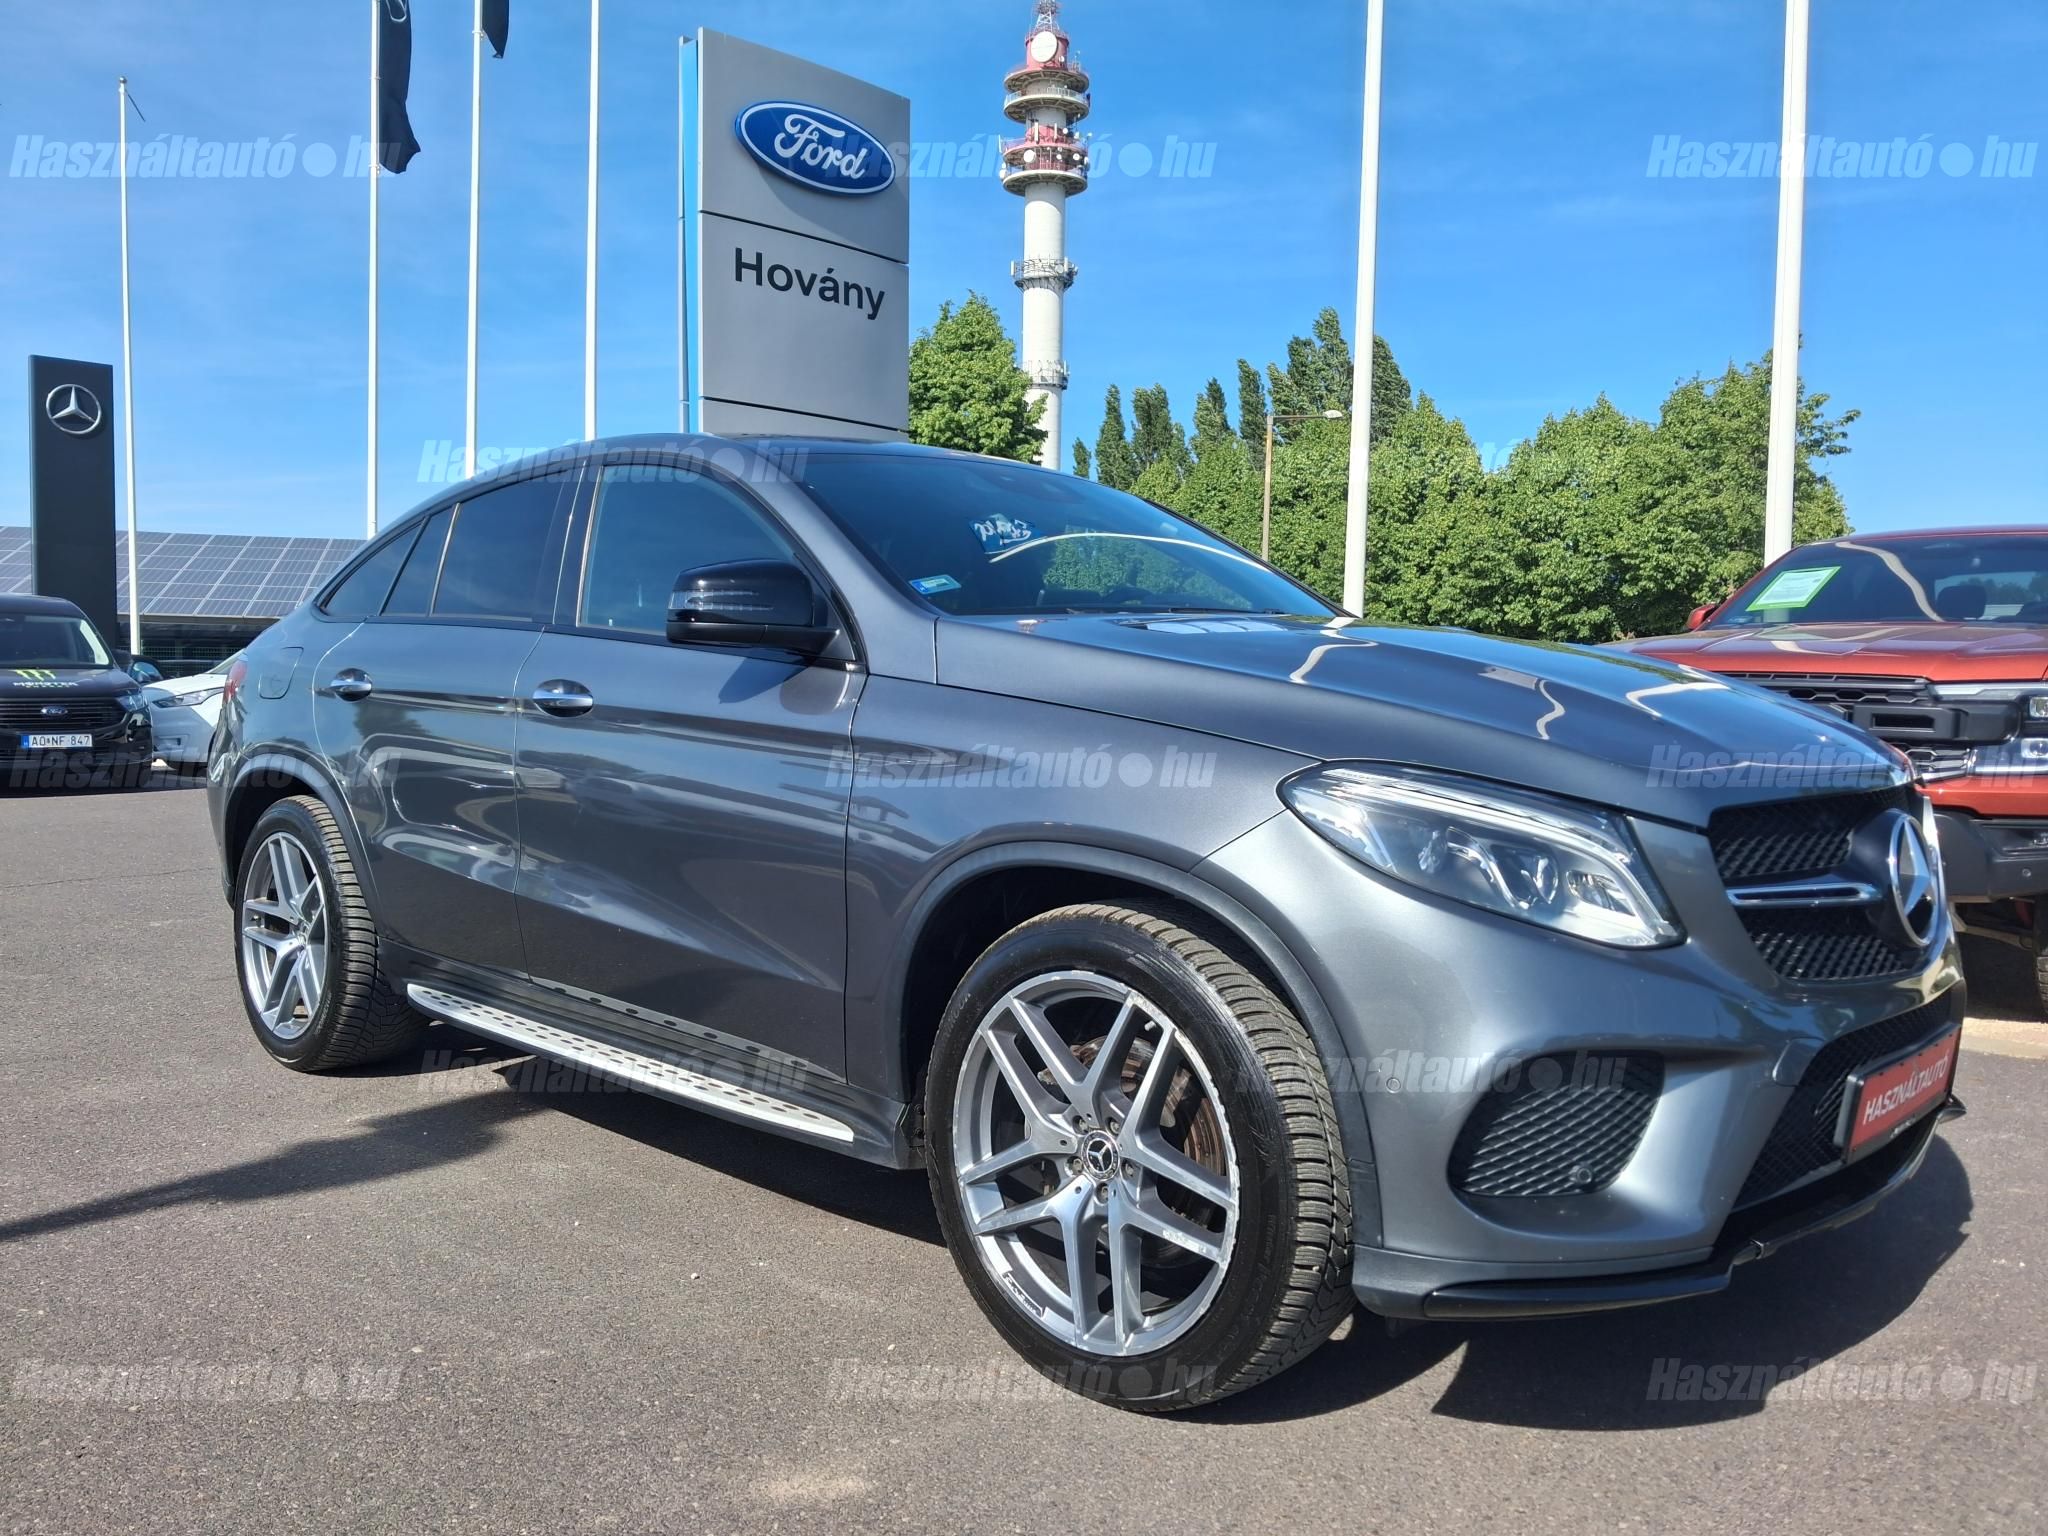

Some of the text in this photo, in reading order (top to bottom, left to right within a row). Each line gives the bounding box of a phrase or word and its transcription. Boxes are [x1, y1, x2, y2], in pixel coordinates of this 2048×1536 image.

[774, 113, 868, 180] Ford
[734, 247, 886, 321] Hovány
[70, 735, 90, 746] 847
[1862, 1049, 1950, 1125] HASZNÁLTAUTÓ
